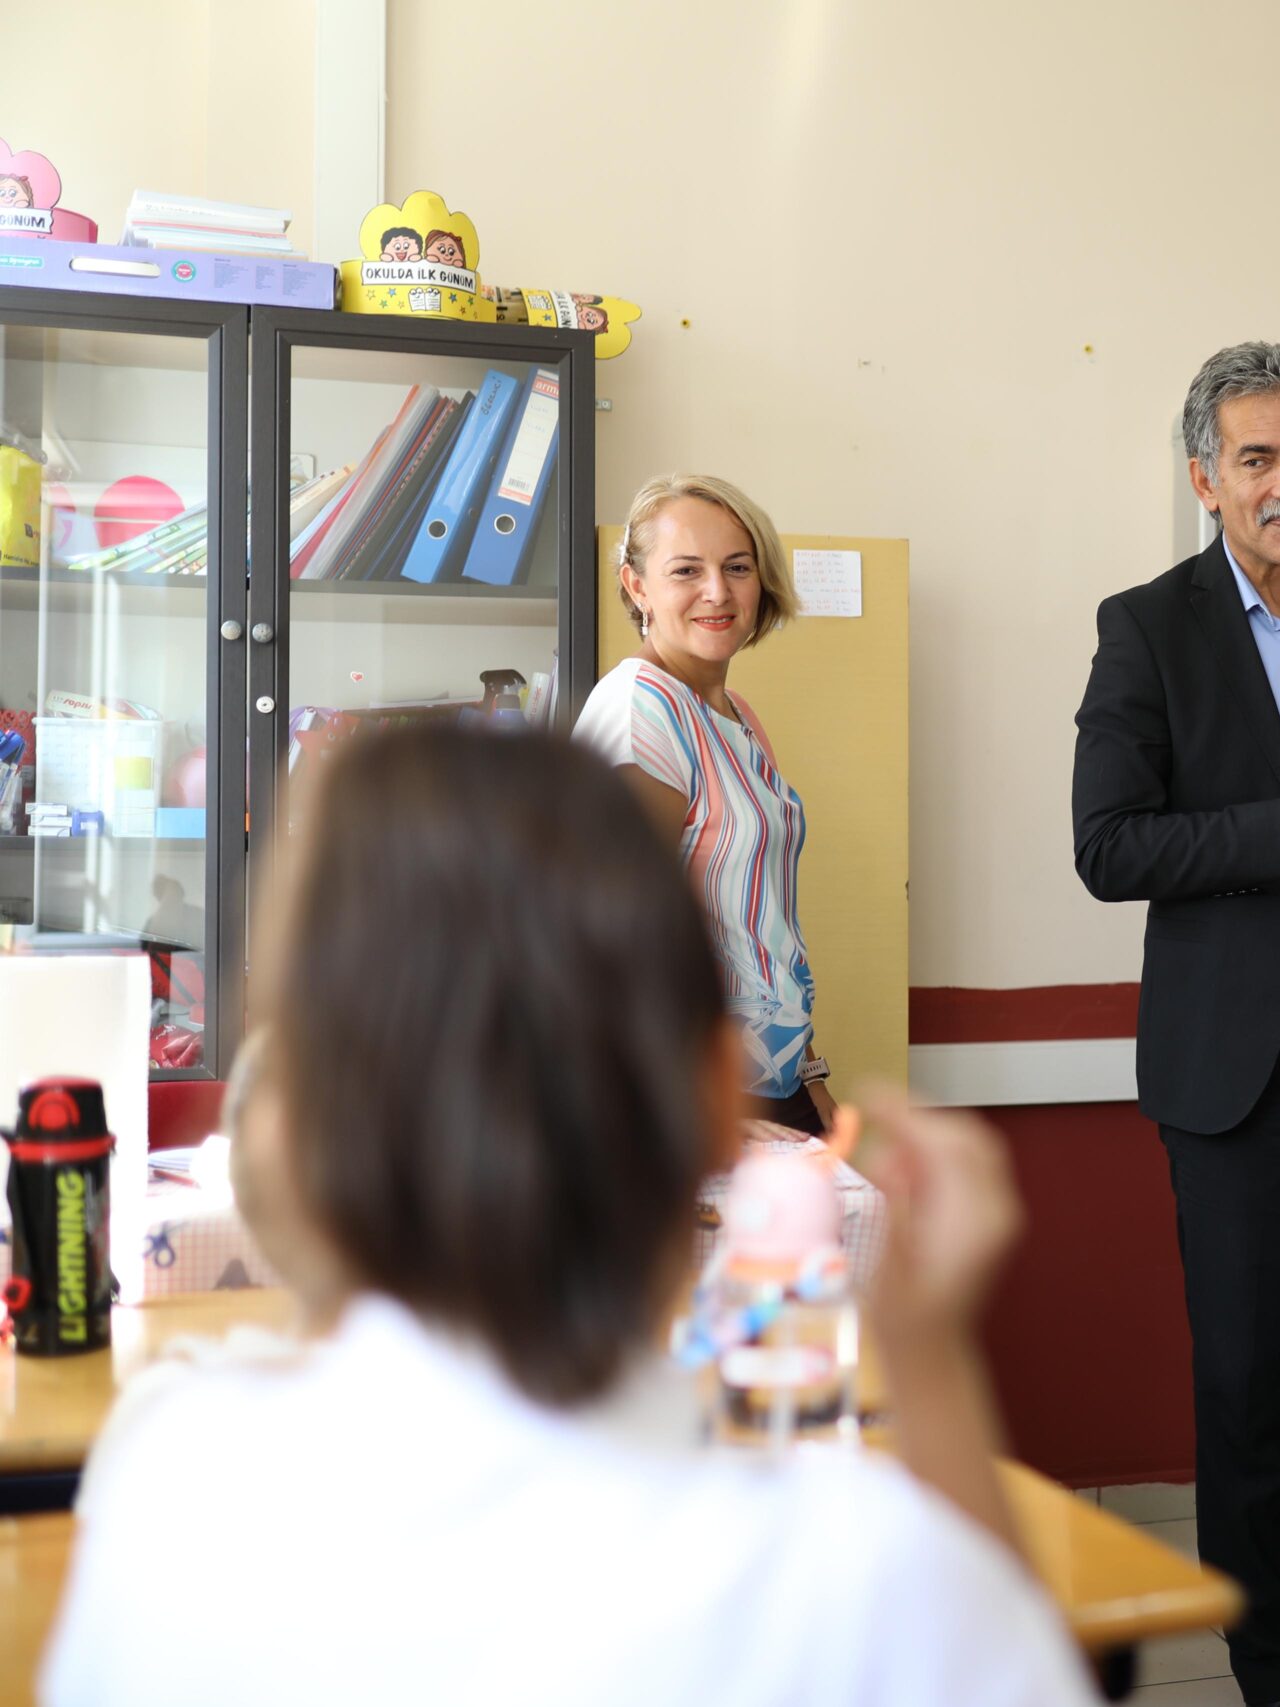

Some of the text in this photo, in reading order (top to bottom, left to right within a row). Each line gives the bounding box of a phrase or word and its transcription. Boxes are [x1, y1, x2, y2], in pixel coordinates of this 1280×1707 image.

[365, 267, 474, 289] OKULDA İLK GÜNÜM
[56, 1171, 87, 1342] LIGHTNING
